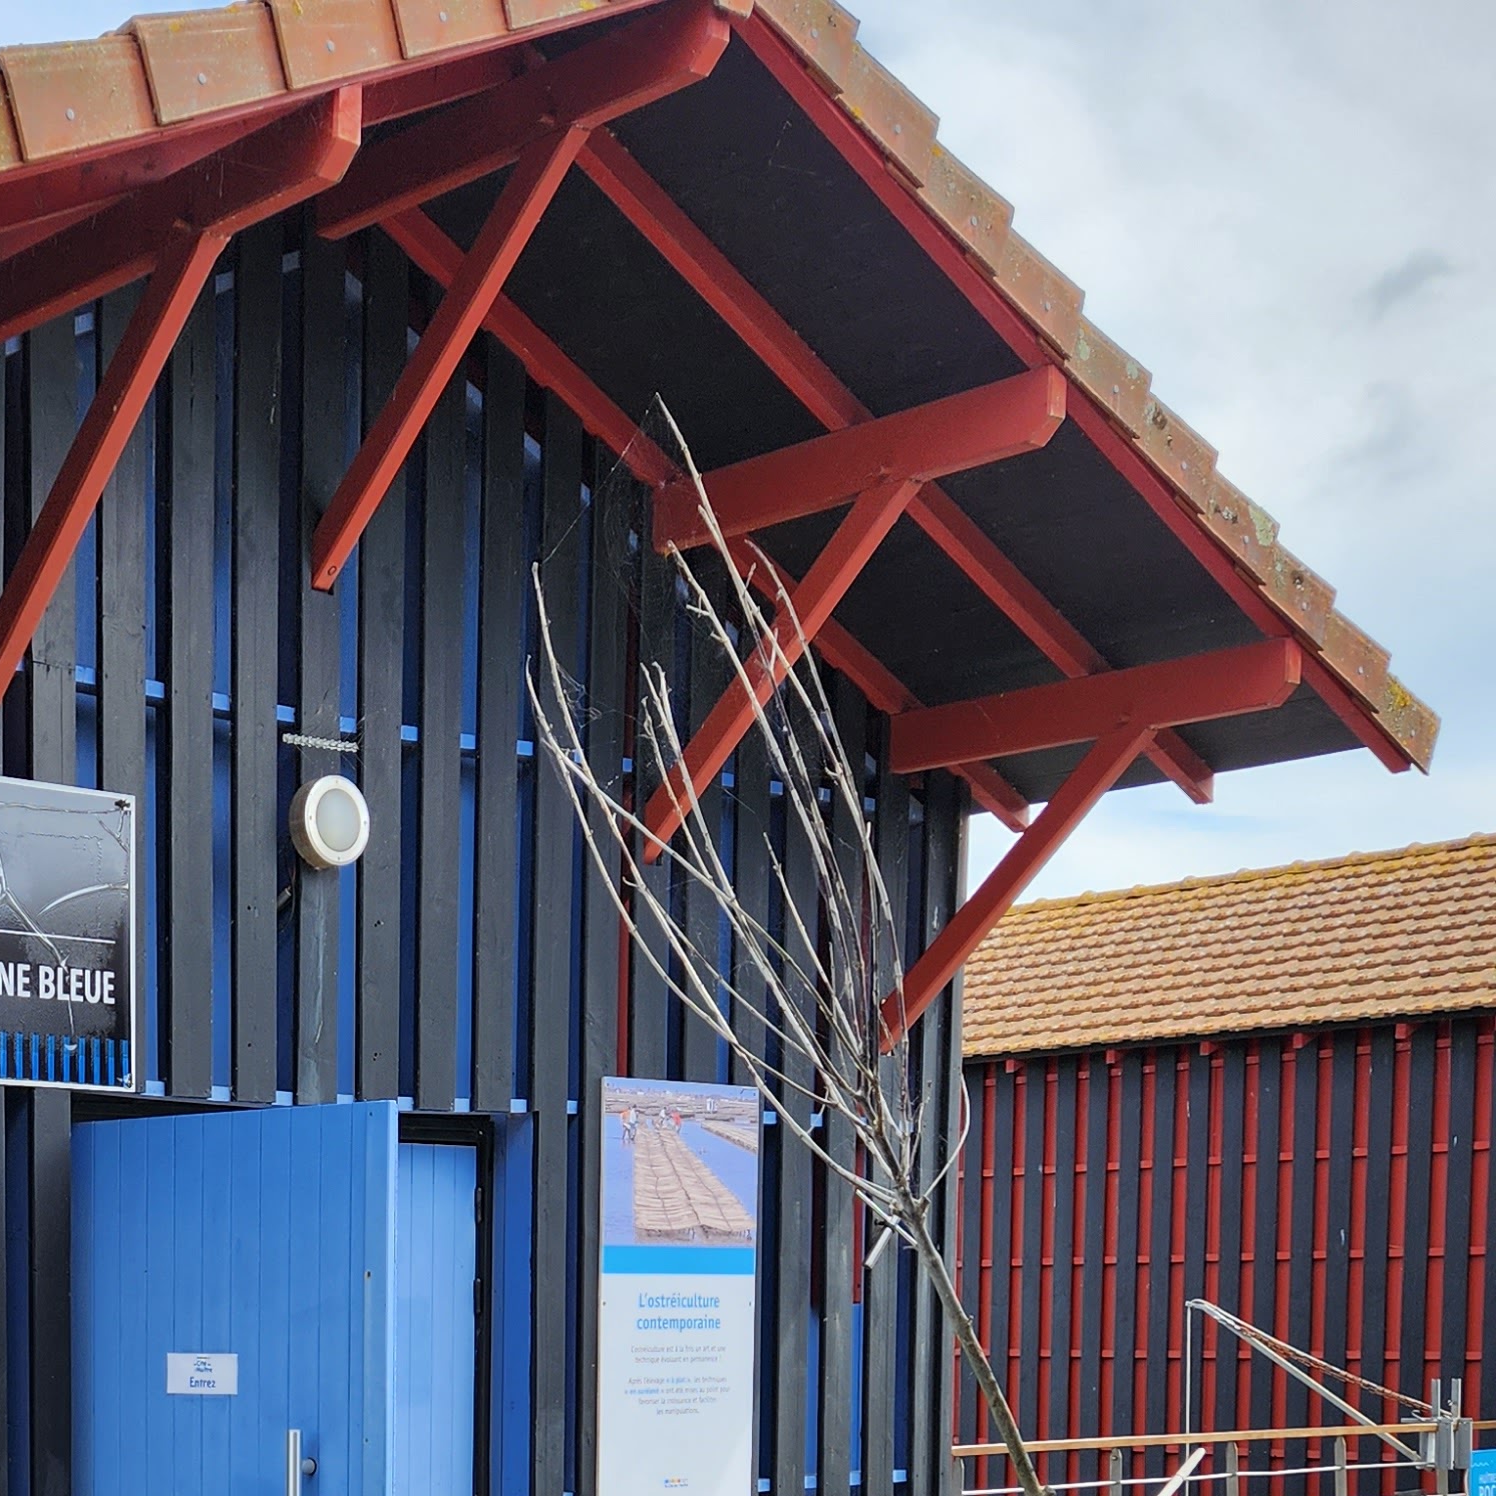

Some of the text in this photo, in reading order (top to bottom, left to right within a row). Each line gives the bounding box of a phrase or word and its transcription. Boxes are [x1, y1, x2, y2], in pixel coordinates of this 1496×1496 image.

[38, 963, 117, 1006] BLEUE
[638, 1292, 721, 1309] L'ostréiculture
[636, 1314, 721, 1333] contemporaine
[189, 1376, 216, 1388] Entrez
